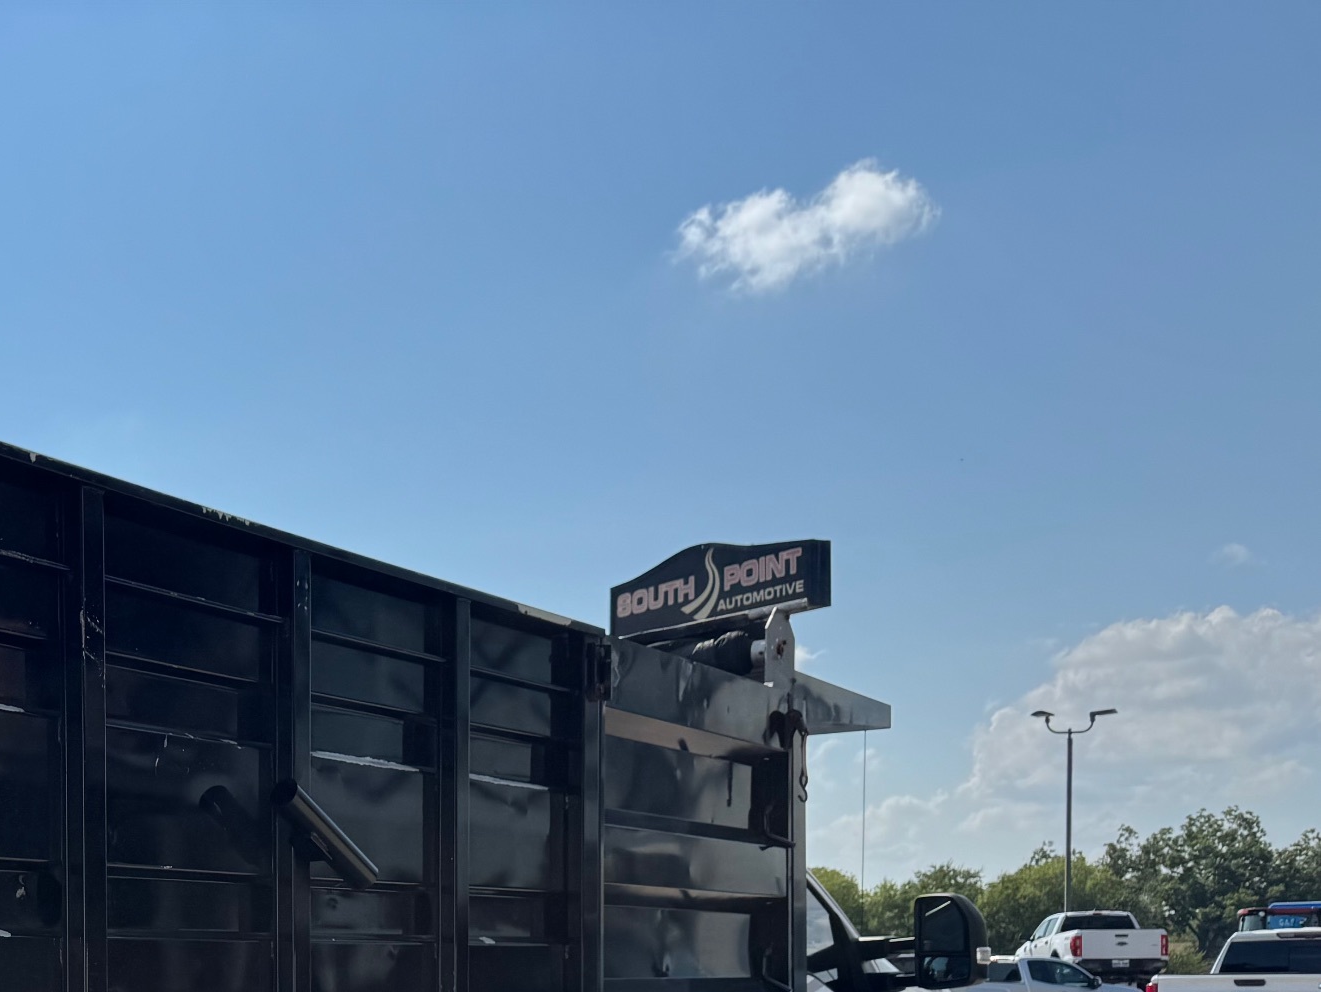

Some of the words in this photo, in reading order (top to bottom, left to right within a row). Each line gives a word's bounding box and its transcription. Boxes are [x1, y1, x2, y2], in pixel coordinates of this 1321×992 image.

[617, 575, 695, 618] SOUTH
[724, 547, 802, 592] POINT
[717, 579, 804, 612] AUTOMOTIVE
